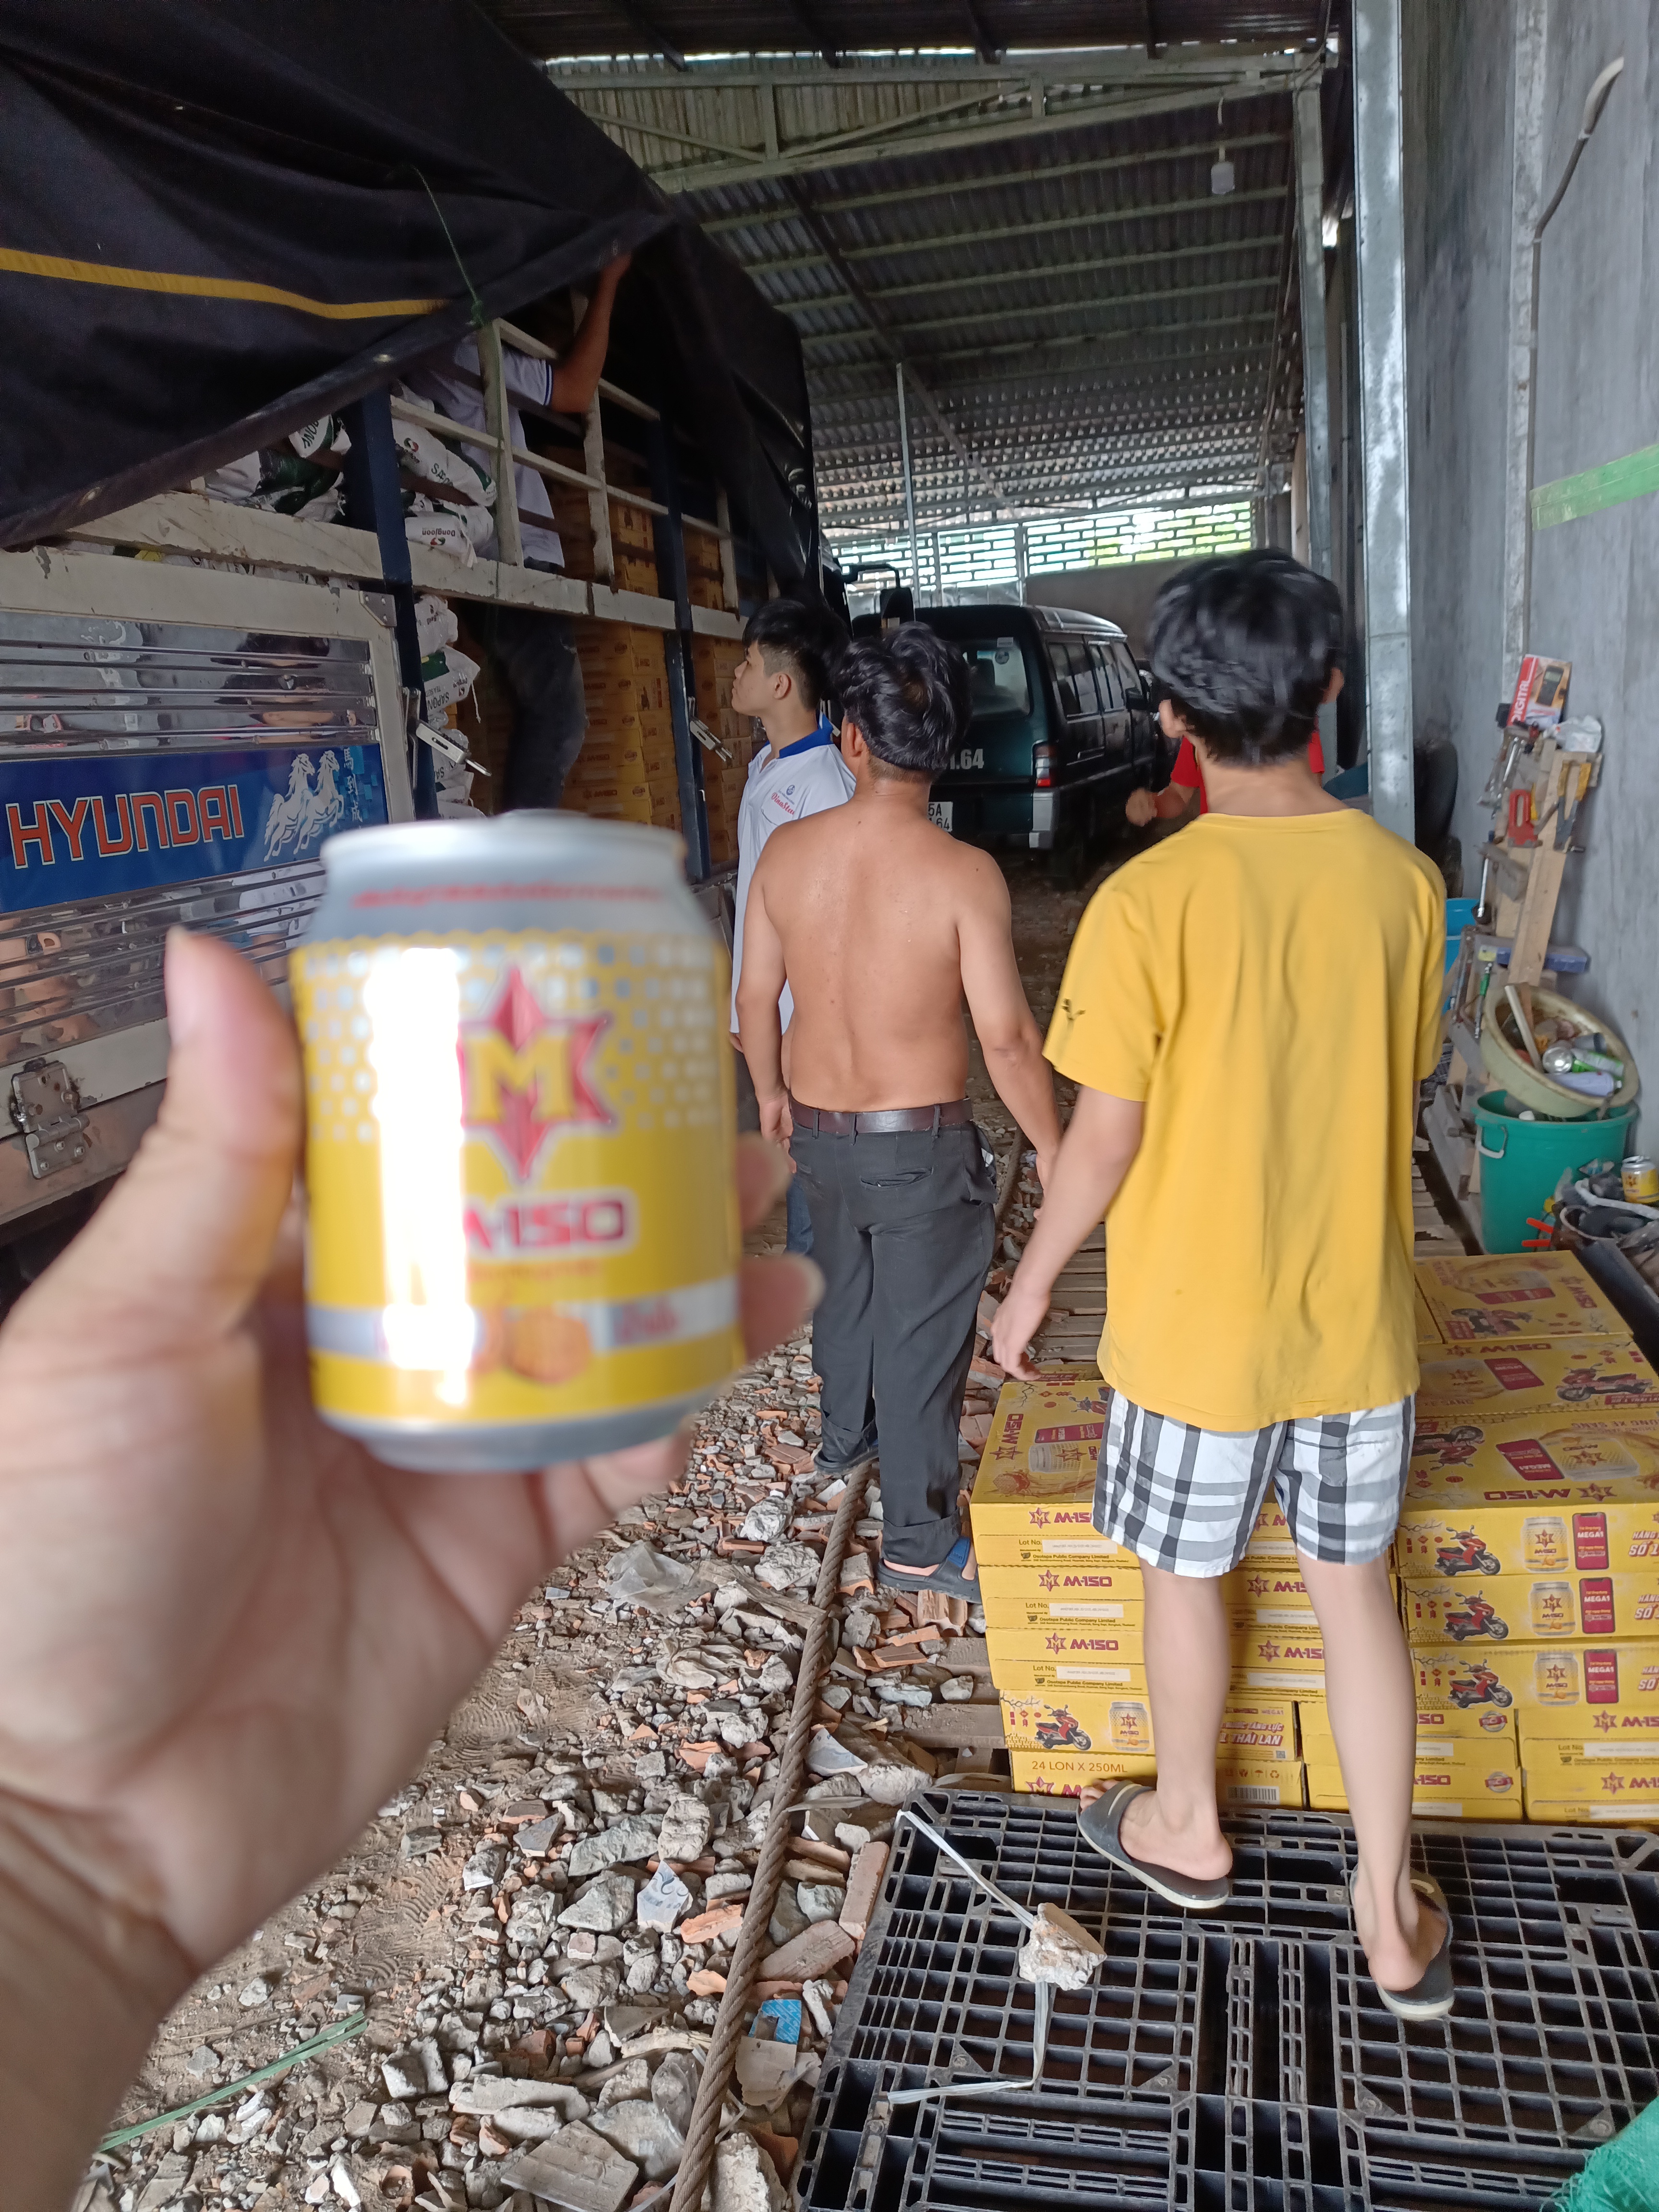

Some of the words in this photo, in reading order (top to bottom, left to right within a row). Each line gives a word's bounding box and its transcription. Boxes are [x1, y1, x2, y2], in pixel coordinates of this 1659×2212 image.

[1511, 657, 1536, 722] DIGITAL
[427, 692, 449, 710] SAPON
[344, 747, 363, 829] 馬到成
[928, 803, 942, 817] 5A
[6, 784, 245, 869] HYUNDAI
[1054, 1512, 1091, 1523] M-15
[1063, 1575, 1113, 1587] M-150
[1273, 1581, 1308, 1593] M-15
[1070, 1638, 1119, 1651] M-150
[1284, 1647, 1324, 1659] M-15
[1622, 1716, 1659, 1727] M-15
[1258, 1734, 1283, 1746] LAN
[1032, 1761, 1046, 1770] 24
[1050, 1761, 1074, 1771] LON
[1078, 1762, 1085, 1771] X
[1089, 1763, 1128, 1773] 250ML
